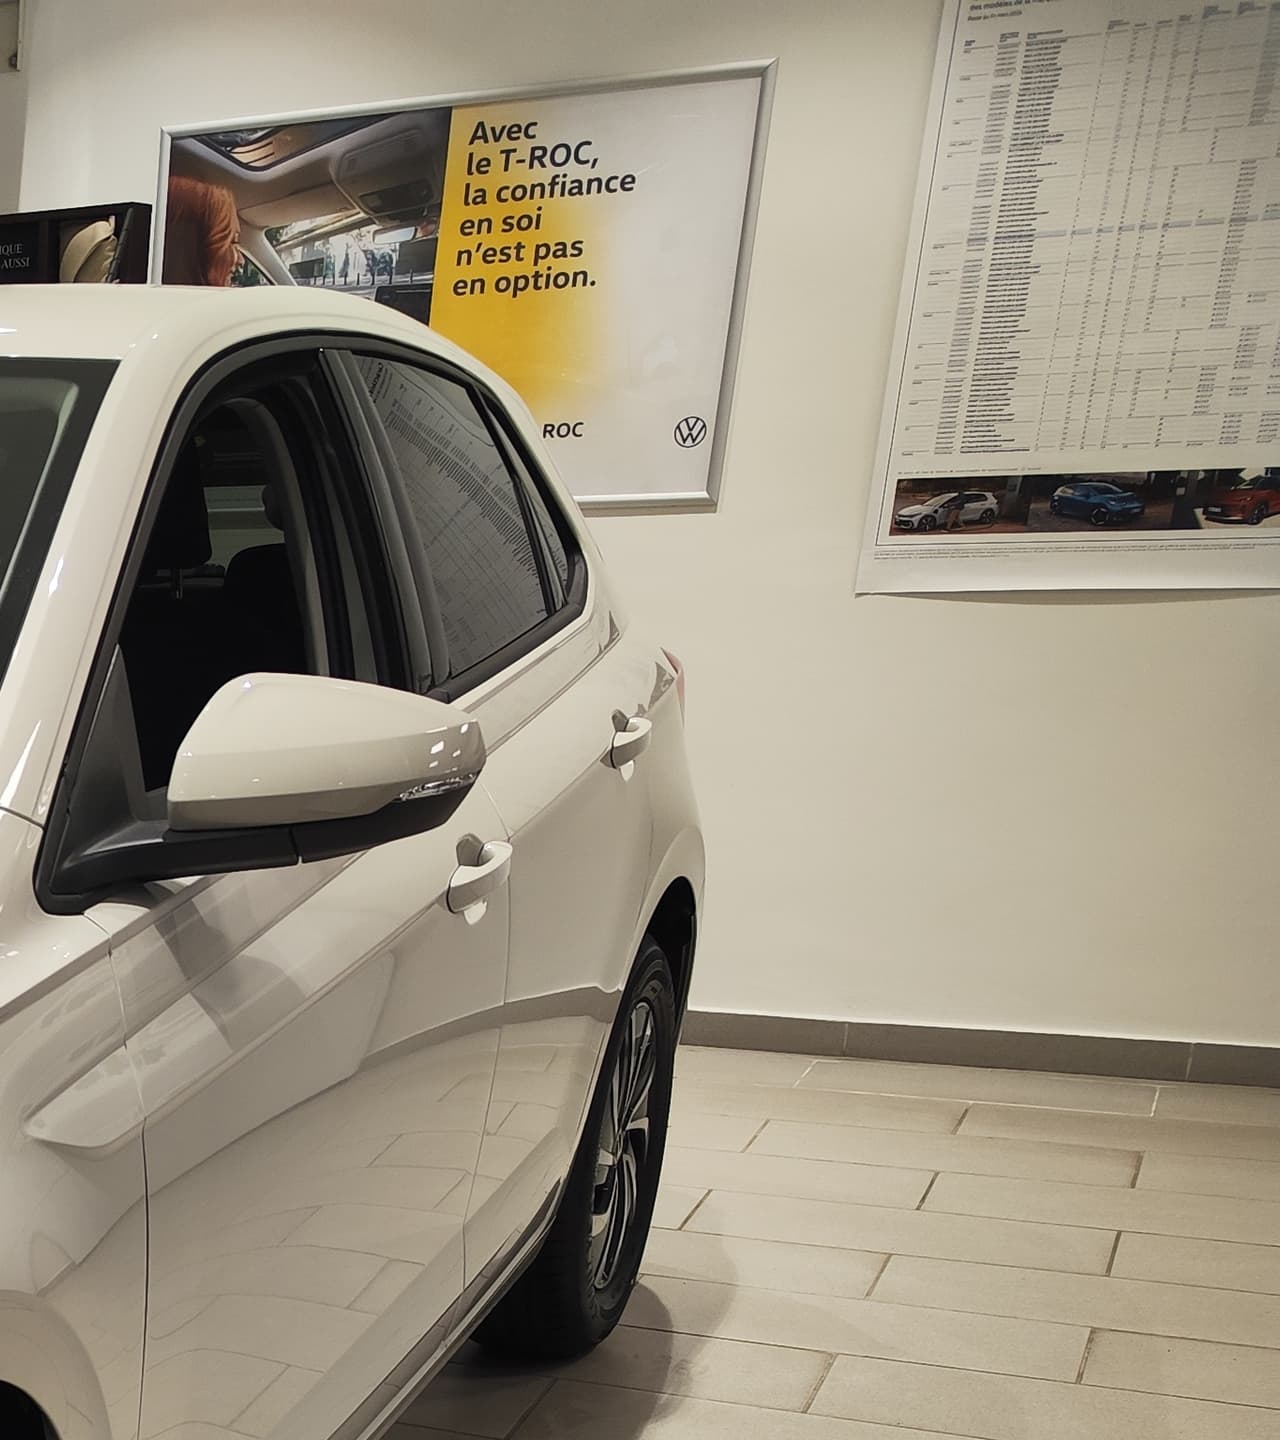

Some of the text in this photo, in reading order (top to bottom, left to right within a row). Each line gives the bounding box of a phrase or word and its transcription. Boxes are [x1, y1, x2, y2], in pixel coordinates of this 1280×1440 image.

[468, 120, 538, 146] Avec
[466, 140, 600, 176] le T-ROC,
[463, 172, 636, 207] la confiance
[459, 206, 542, 237] en soi
[1, 256, 30, 270] AUSSI
[455, 238, 584, 267] n'est pas
[452, 267, 597, 299] en option.
